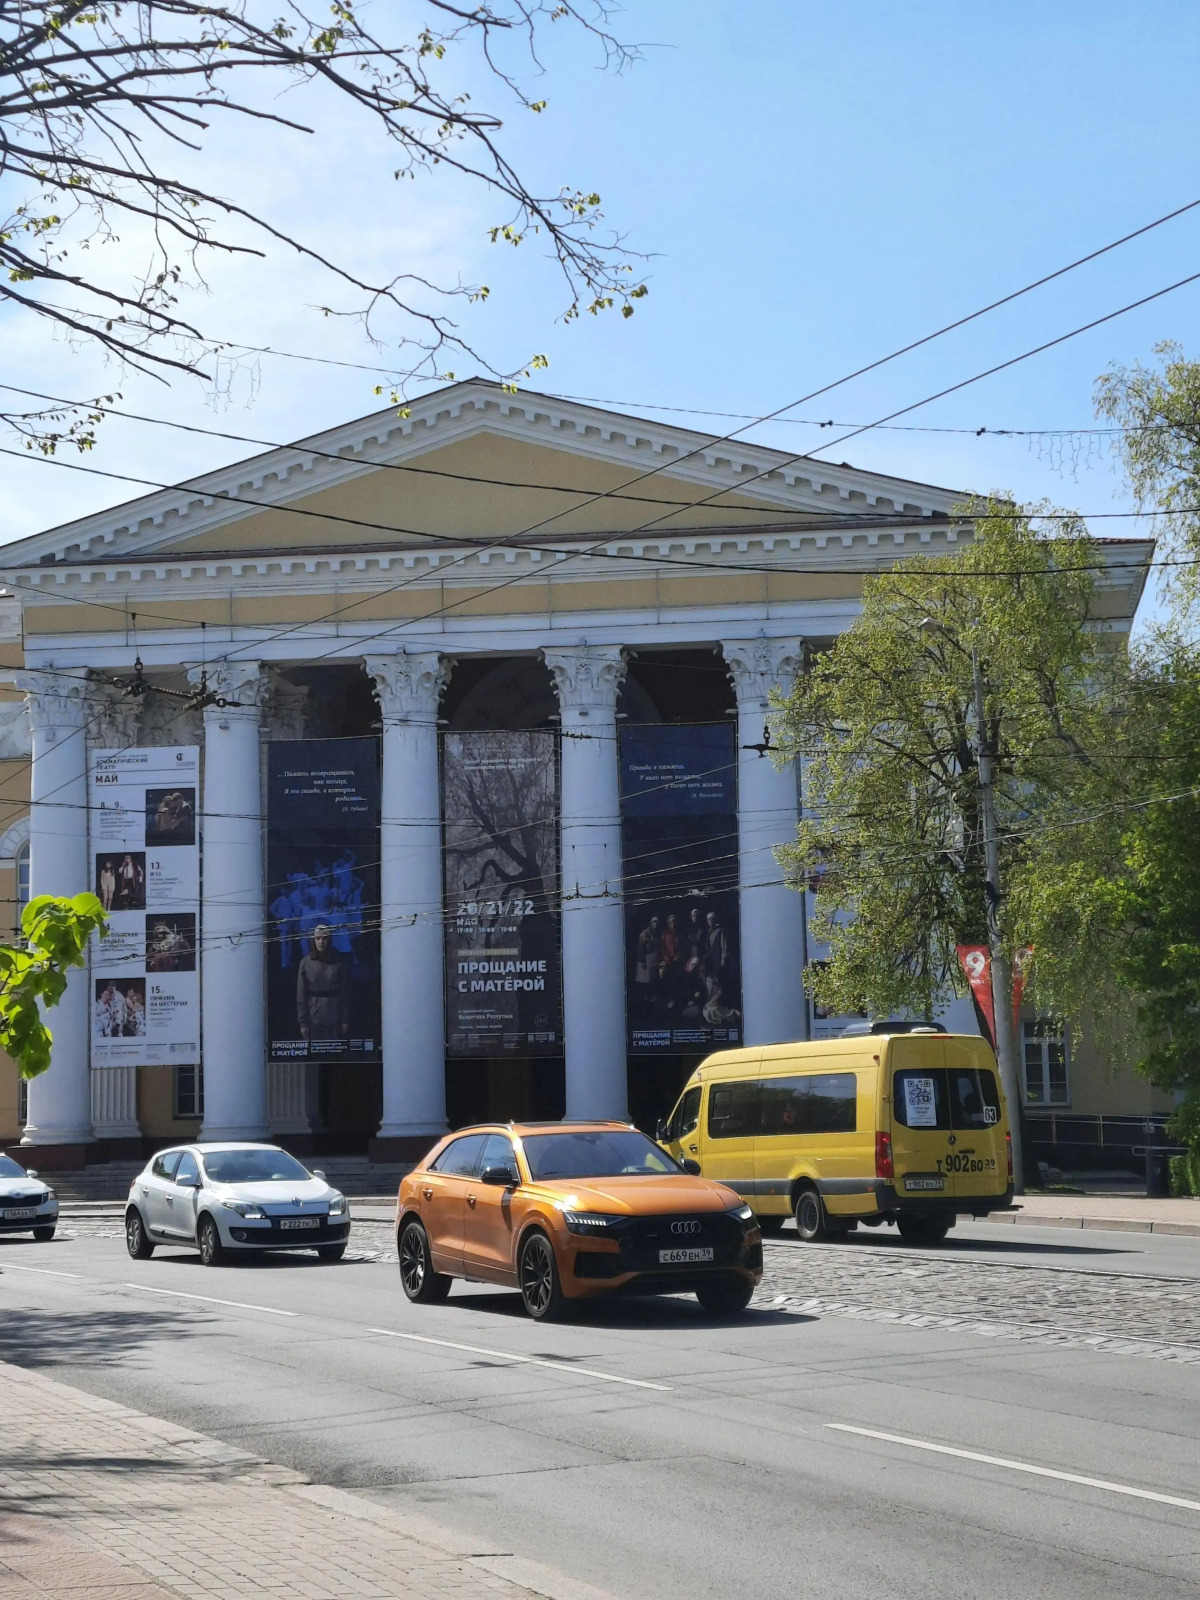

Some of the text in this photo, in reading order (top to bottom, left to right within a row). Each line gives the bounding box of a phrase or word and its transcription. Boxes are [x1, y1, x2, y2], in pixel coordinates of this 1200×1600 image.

[96, 774, 118, 783] МАЙ
[458, 960, 547, 975] ПРОЩАНИЕ
[966, 952, 985, 977] 9
[151, 986, 160, 994] 15
[458, 976, 545, 992] С МАТЁРОЙ
[985, 1108, 995, 1121] 63
